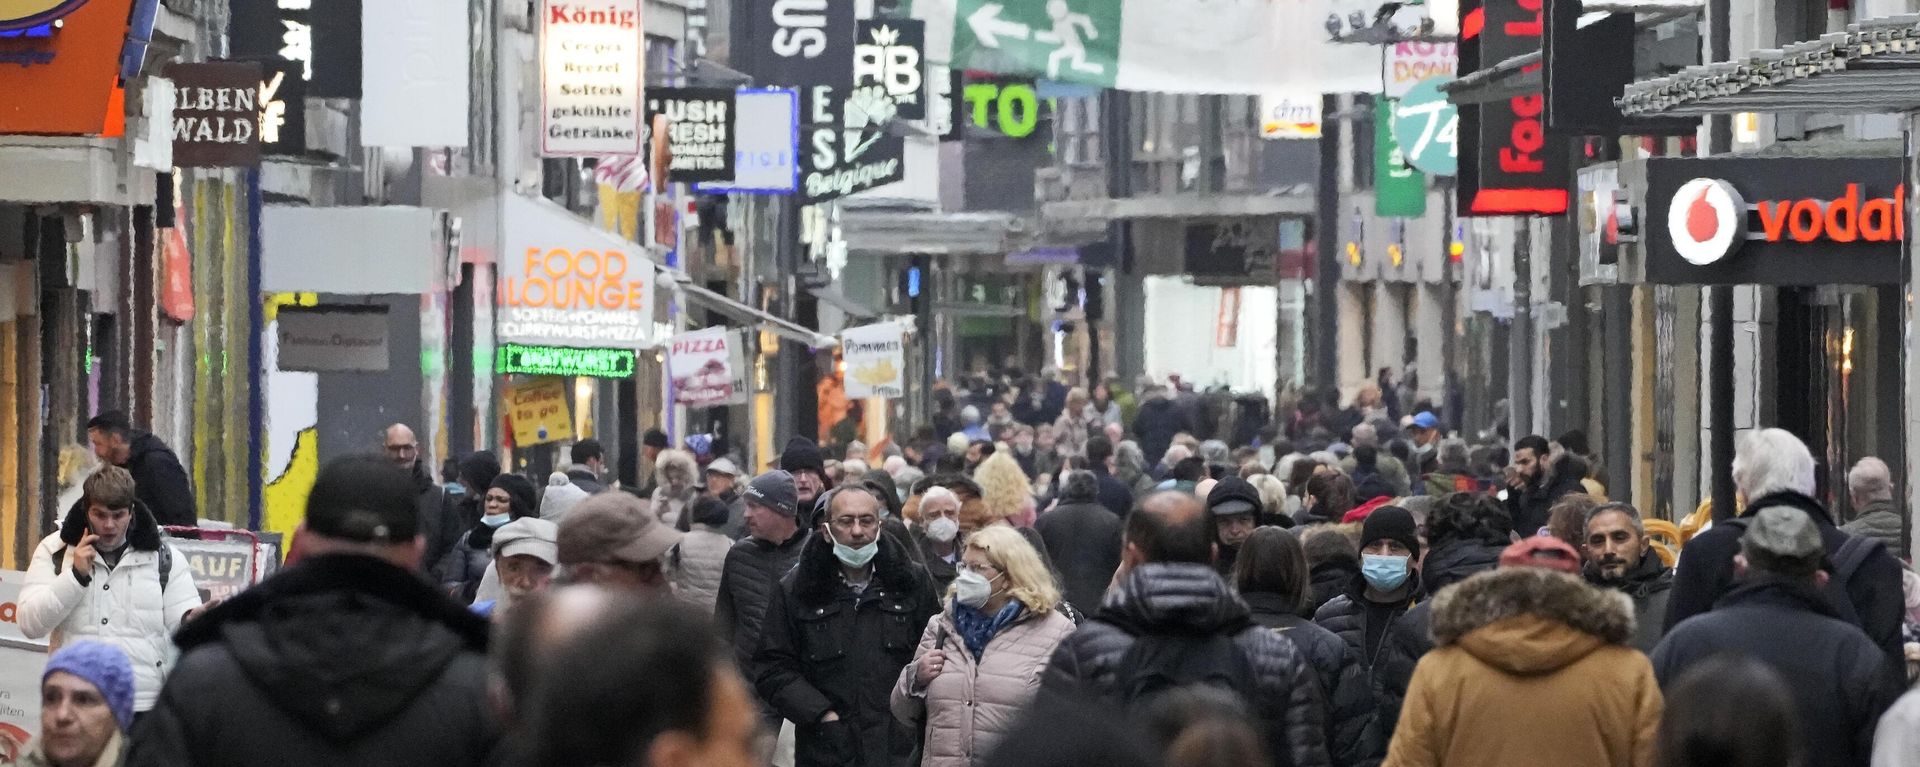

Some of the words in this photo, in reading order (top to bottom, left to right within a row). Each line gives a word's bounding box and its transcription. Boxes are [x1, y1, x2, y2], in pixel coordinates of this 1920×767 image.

[550, 4, 634, 28] König
[560, 83, 623, 97] Softeis
[552, 103, 632, 119] gekühlte
[650, 99, 727, 123] USH
[172, 116, 254, 144] WALD
[549, 122, 634, 140] Getränke
[805, 158, 899, 198] Belgique
[525, 247, 627, 280] FOOD
[506, 276, 643, 311] LOUNGE
[672, 338, 726, 355] PIZZA
